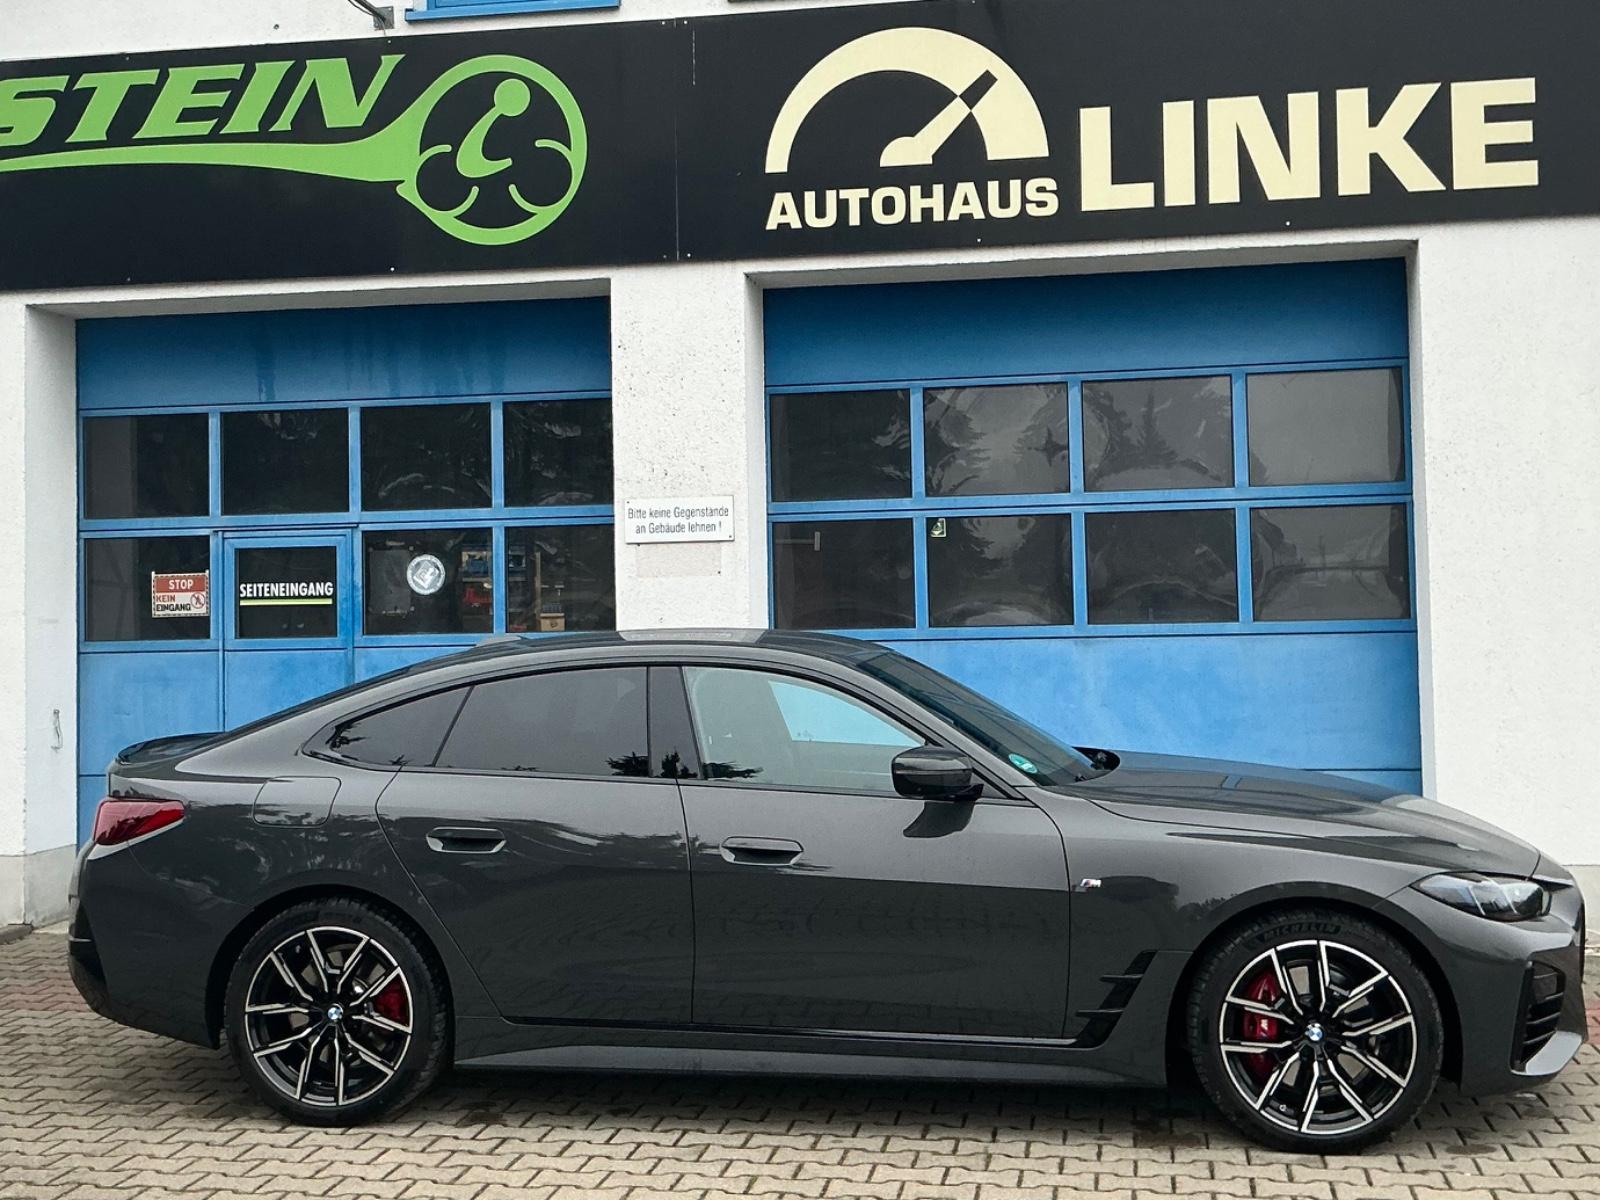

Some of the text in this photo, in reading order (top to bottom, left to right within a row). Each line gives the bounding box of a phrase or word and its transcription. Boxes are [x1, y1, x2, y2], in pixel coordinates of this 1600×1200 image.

[0, 53, 405, 147] STEIN
[1079, 76, 1539, 213] LINKE
[765, 176, 1059, 231] AUTOHAUS
[628, 508, 647, 519] Bitte
[649, 507, 671, 519] keine
[635, 525, 646, 534] an
[688, 521, 716, 533] lehnen
[169, 579, 193, 589] STOP
[240, 582, 333, 597] SEITENEINGANG
[156, 594, 175, 602] KEIN
[156, 603, 191, 611] EINGANG
[1263, 922, 1337, 941] MICHELIN
